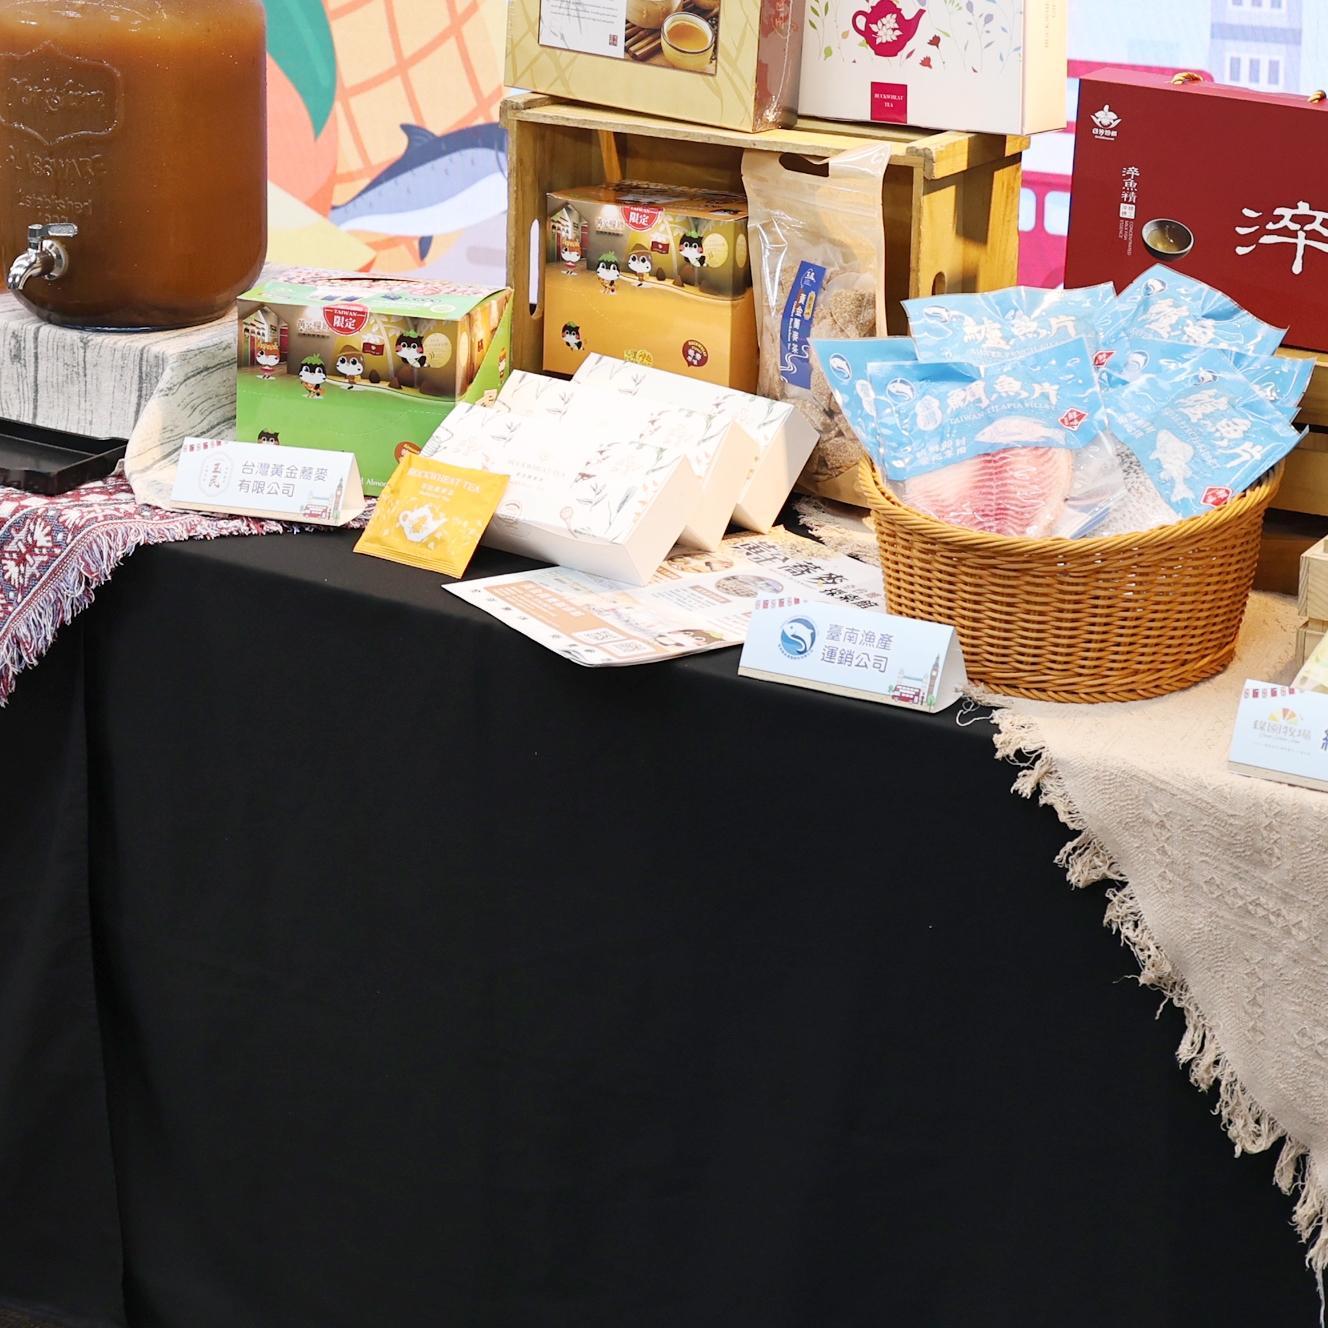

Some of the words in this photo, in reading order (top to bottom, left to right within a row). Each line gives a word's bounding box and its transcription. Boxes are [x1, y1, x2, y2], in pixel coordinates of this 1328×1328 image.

[629, 211, 650, 227] 限定
[333, 316, 356, 329] 限定
[334, 308, 357, 317] TAIWAN
[946, 374, 1060, 414] 鯛魚片
[949, 411, 984, 425] TAIWAN
[241, 460, 329, 483] 台灣黃金蕎麥
[407, 467, 462, 487] BUCKWHEAT
[462, 481, 481, 494] TEA
[238, 479, 296, 498] 有限公司
[825, 622, 894, 651] 臺南漁產
[820, 645, 889, 673] 運銷公司
